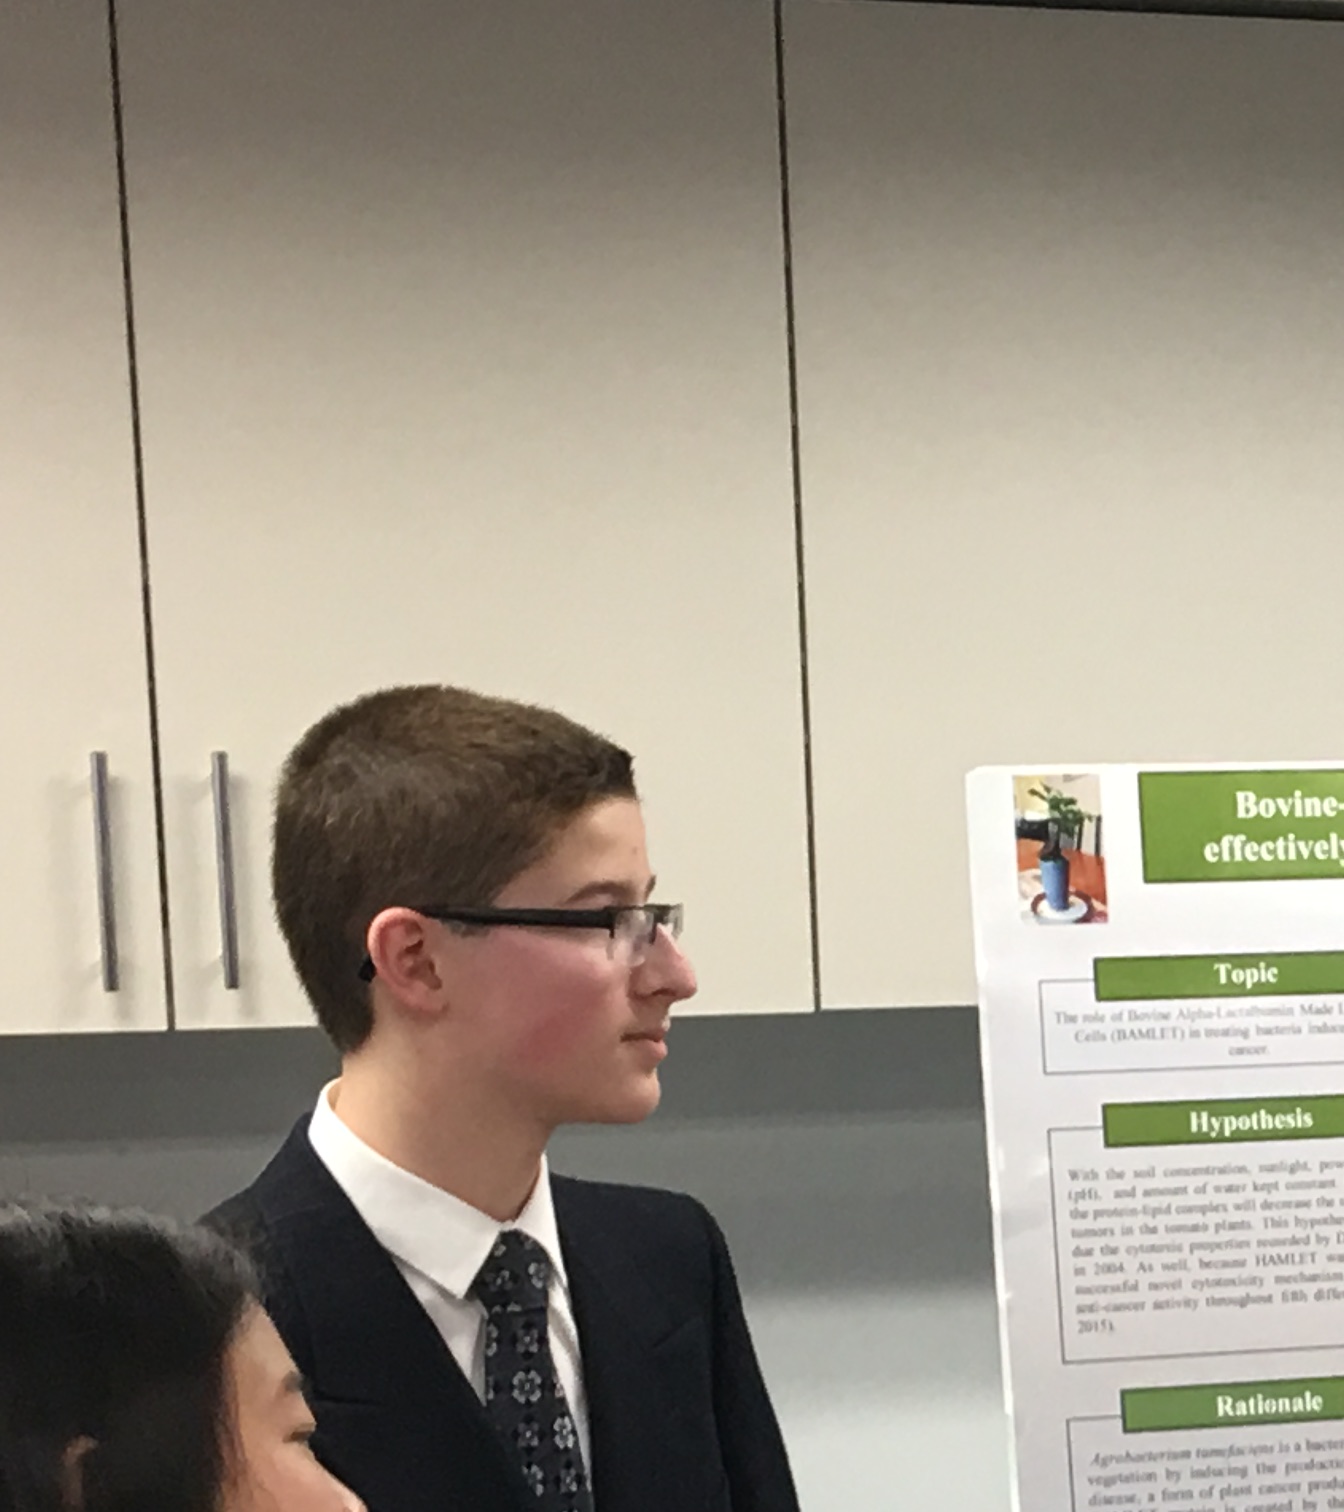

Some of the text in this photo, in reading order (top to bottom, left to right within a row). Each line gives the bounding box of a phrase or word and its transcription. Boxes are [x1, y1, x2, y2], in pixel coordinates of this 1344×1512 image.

[1213, 961, 1278, 989] Topic
[1190, 1107, 1313, 1138] Hypothesis
[1217, 1390, 1322, 1417] Rationale
